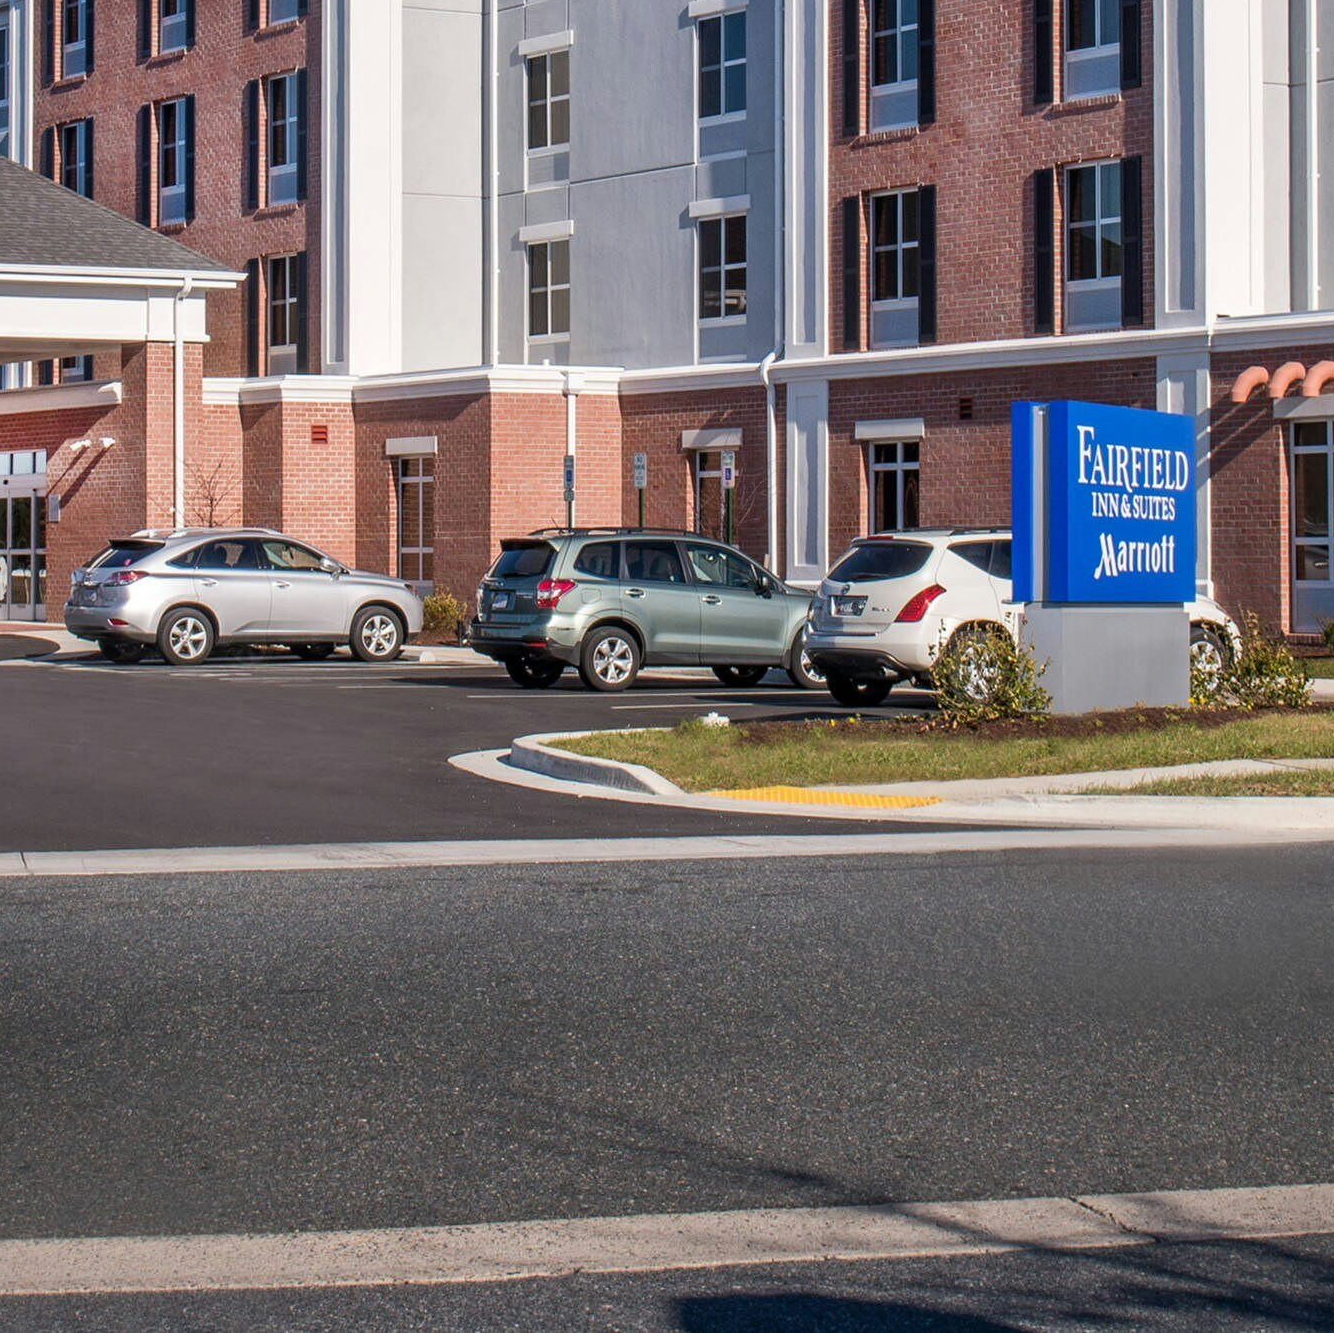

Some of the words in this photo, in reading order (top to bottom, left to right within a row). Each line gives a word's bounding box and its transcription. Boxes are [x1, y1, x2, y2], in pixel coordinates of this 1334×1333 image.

[1076, 424, 1189, 493] FAIRFIELD
[1091, 491, 1119, 517] INN
[1120, 493, 1132, 518] &
[1132, 494, 1175, 521] SUITES
[1094, 532, 1175, 580] Marriott
